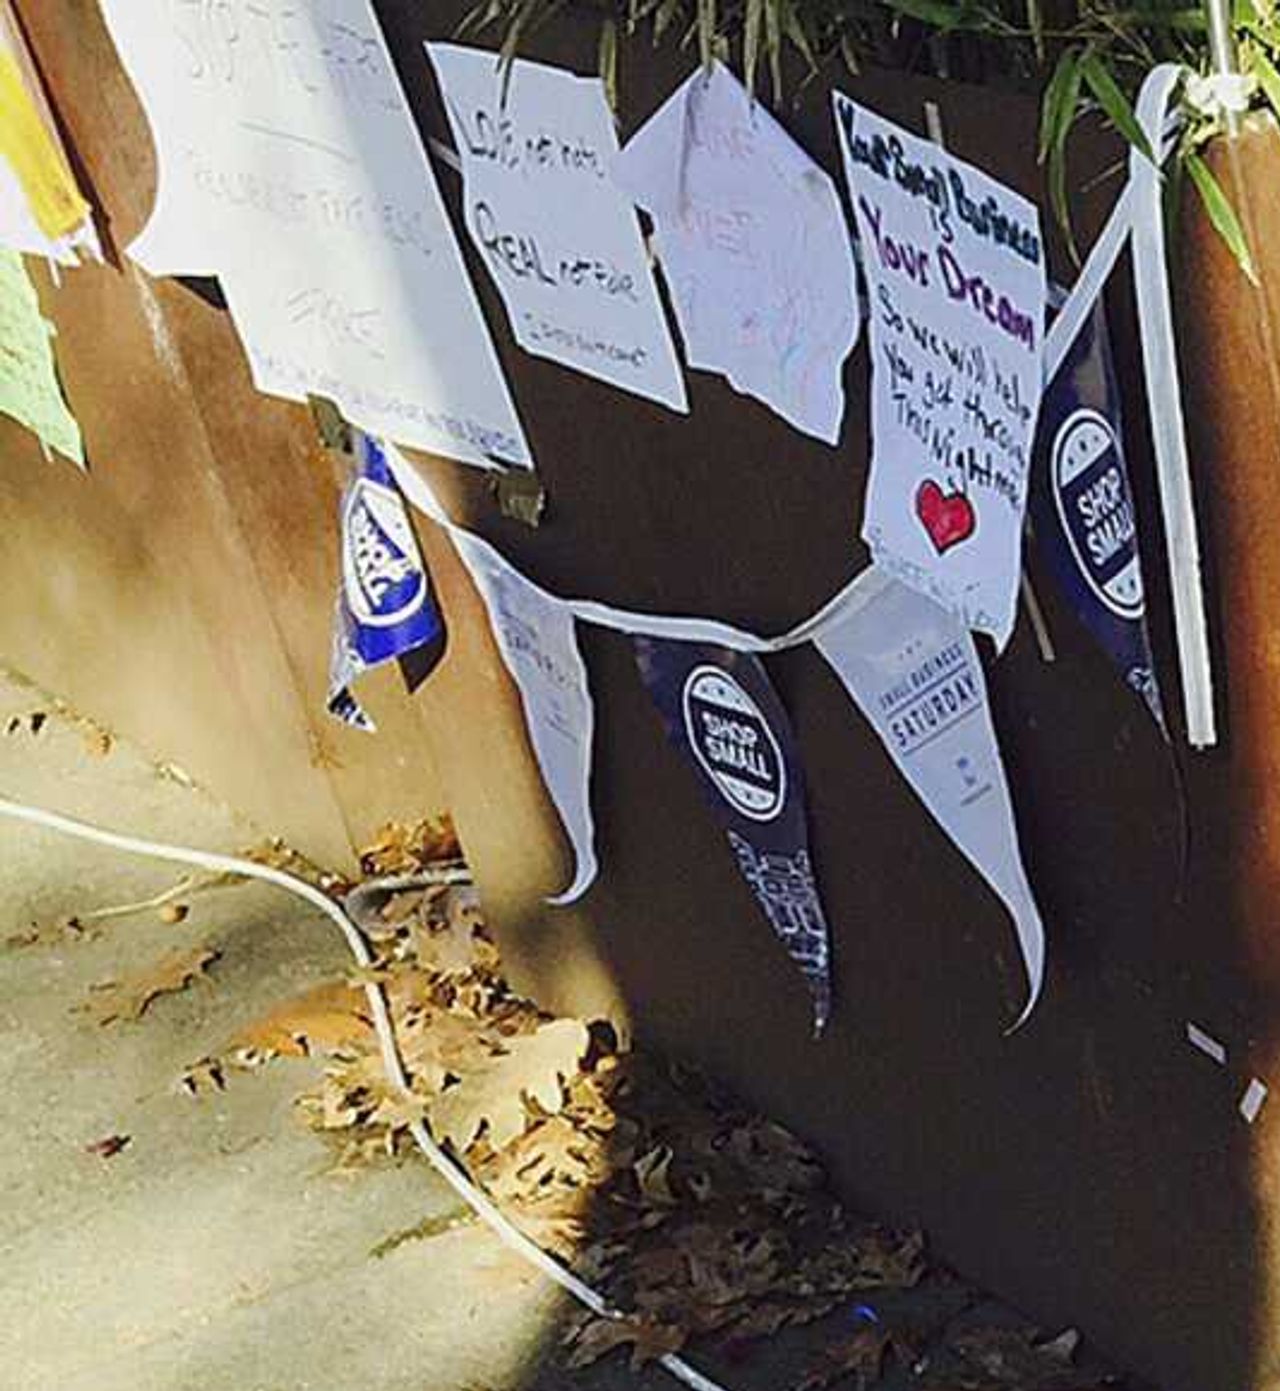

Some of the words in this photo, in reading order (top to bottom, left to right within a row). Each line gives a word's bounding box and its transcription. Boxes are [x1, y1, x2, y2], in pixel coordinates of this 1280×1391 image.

[857, 194, 929, 287] Your
[935, 243, 1036, 353] Dream
[1076, 465, 1122, 530] SHOP
[892, 668, 979, 747] SATURDAY
